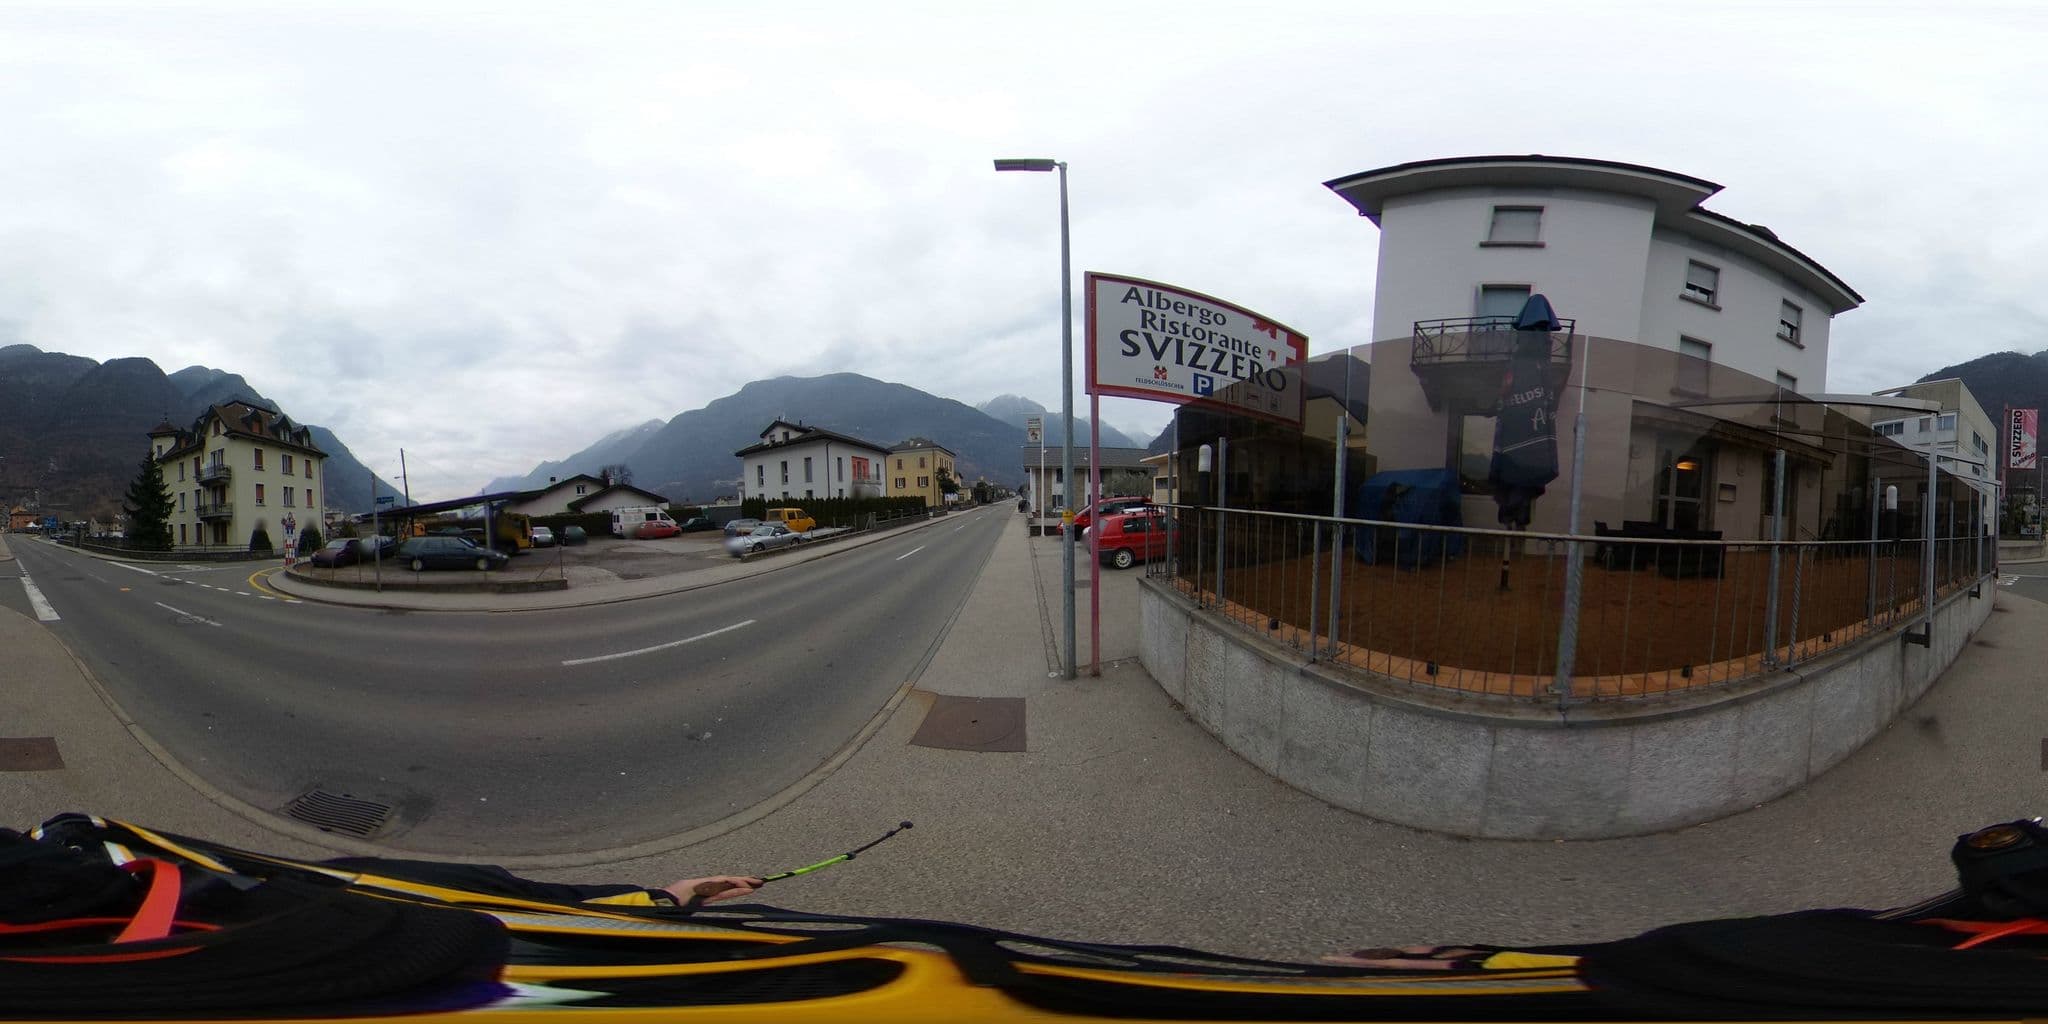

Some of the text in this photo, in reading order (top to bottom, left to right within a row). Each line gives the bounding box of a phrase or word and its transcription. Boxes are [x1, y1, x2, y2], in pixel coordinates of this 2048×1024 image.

[1121, 286, 1227, 326] Albergo
[1140, 309, 1262, 359] Ristorante
[1119, 329, 1287, 392] SVIZZERO
[1197, 375, 1210, 395] P
[2012, 410, 2023, 457] SVIZZERO
